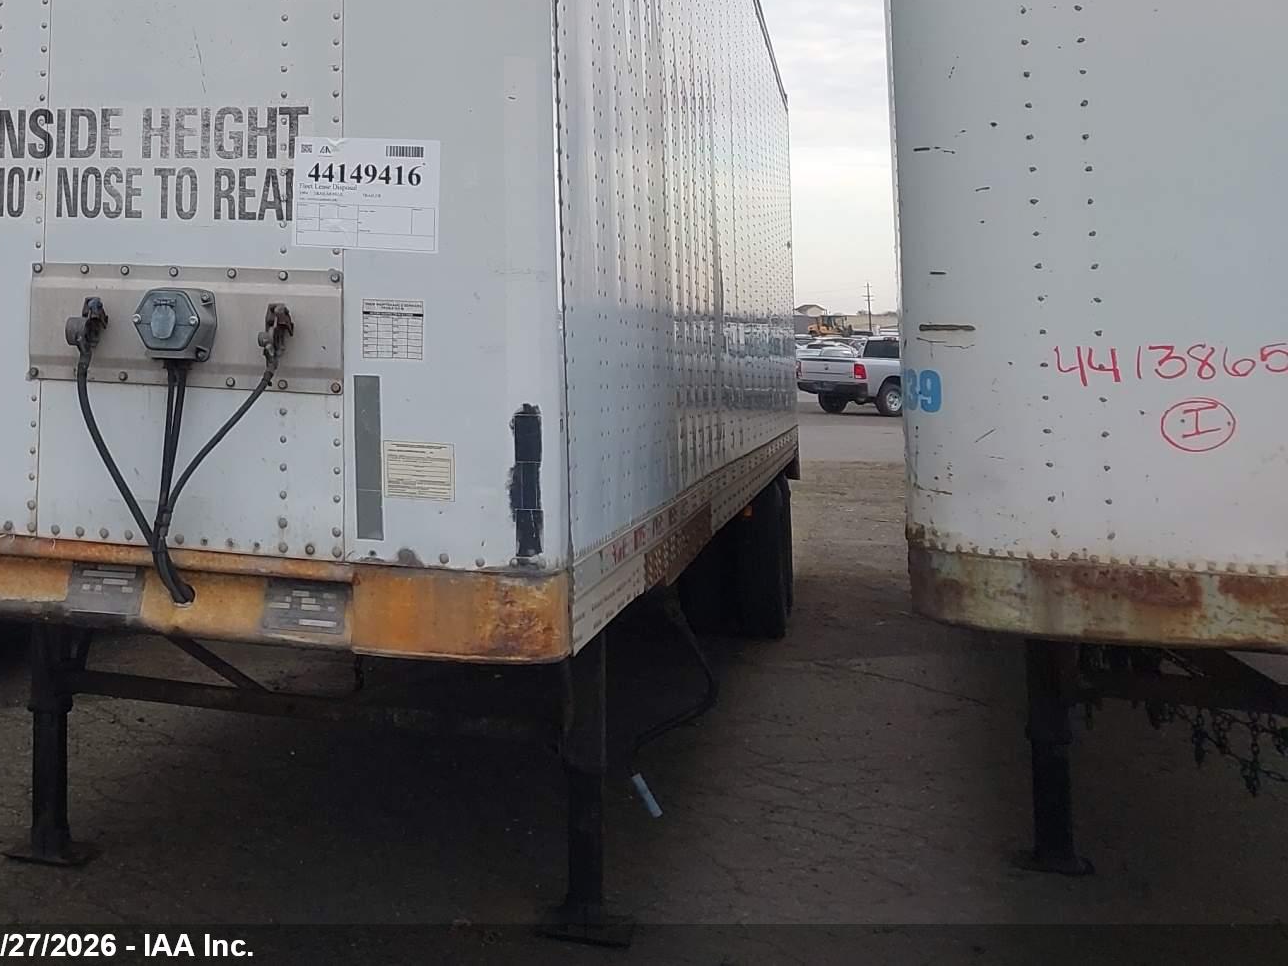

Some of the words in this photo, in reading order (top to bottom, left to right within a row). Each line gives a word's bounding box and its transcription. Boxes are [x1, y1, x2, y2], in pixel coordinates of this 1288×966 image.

[142, 106, 309, 160] HEIGHT
[56, 166, 143, 219] NOSE
[154, 167, 198, 220] TO
[308, 163, 422, 186] 44149416
[332, 183, 358, 191] Disposal
